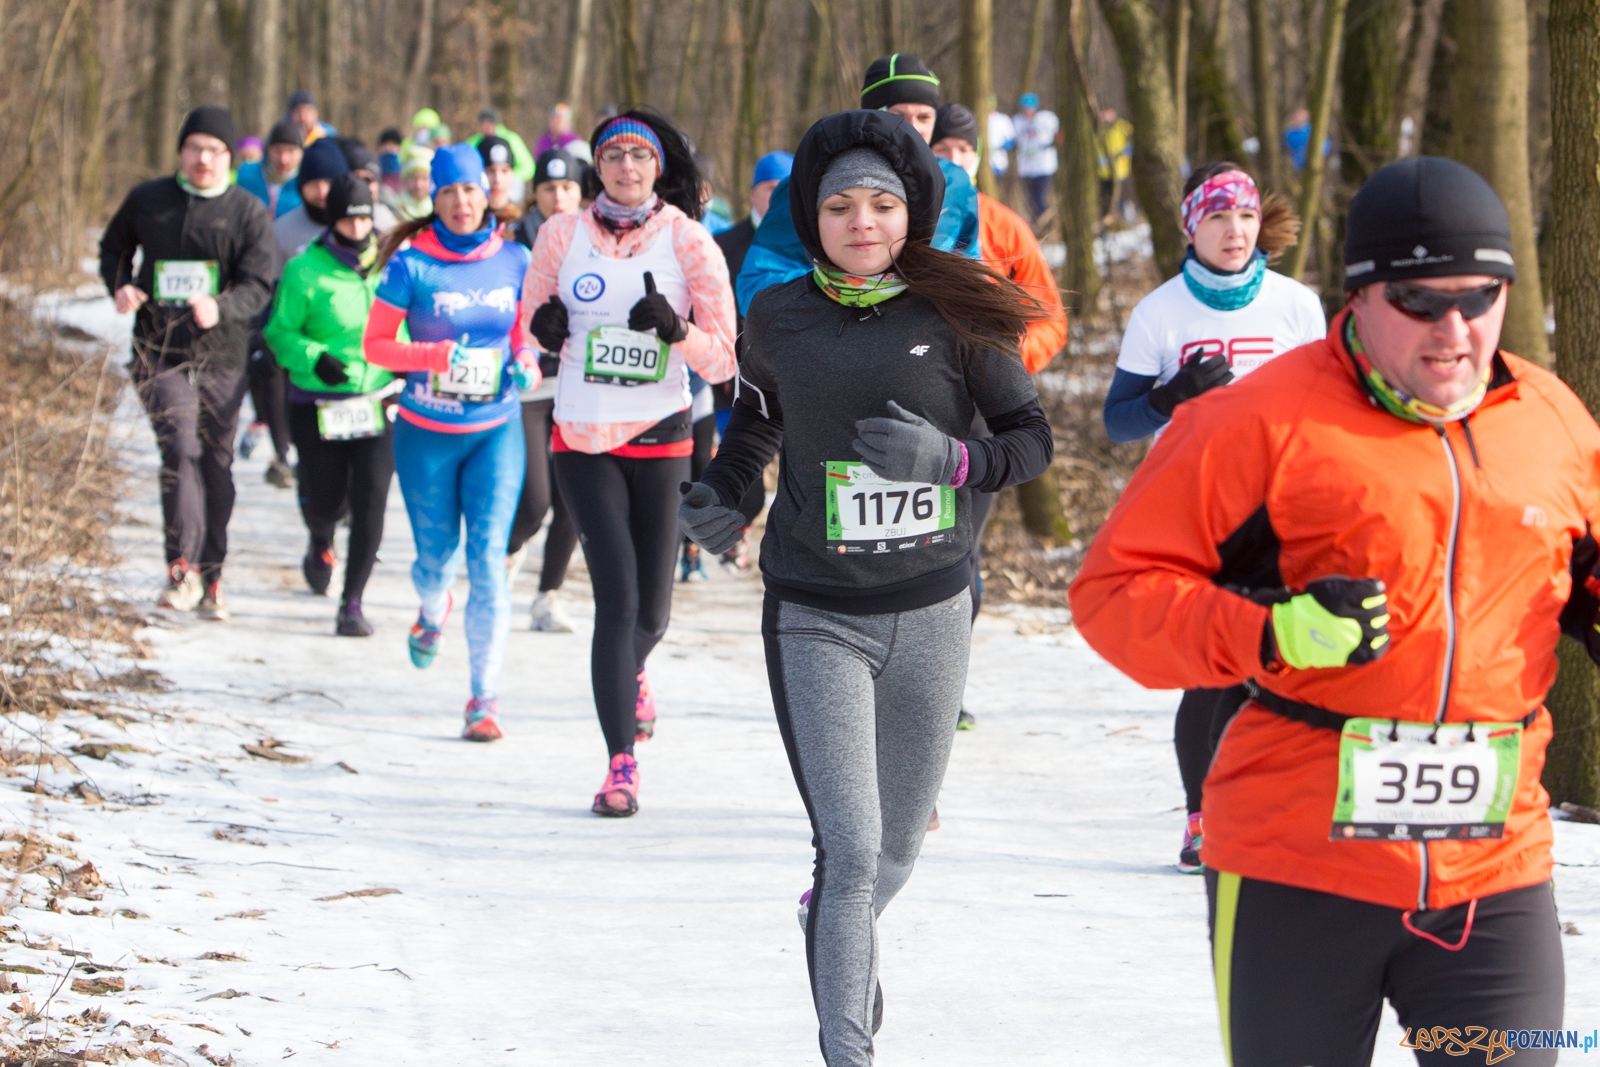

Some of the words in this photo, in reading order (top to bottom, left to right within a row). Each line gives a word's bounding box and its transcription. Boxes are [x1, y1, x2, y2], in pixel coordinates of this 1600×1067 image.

[165, 276, 203, 292] 1757
[595, 344, 658, 369] 2090
[909, 345, 930, 356] 4F
[449, 364, 492, 385] 1212
[852, 487, 933, 525] 1176
[884, 528, 906, 537] ZBUJ
[1375, 762, 1480, 804] 359
